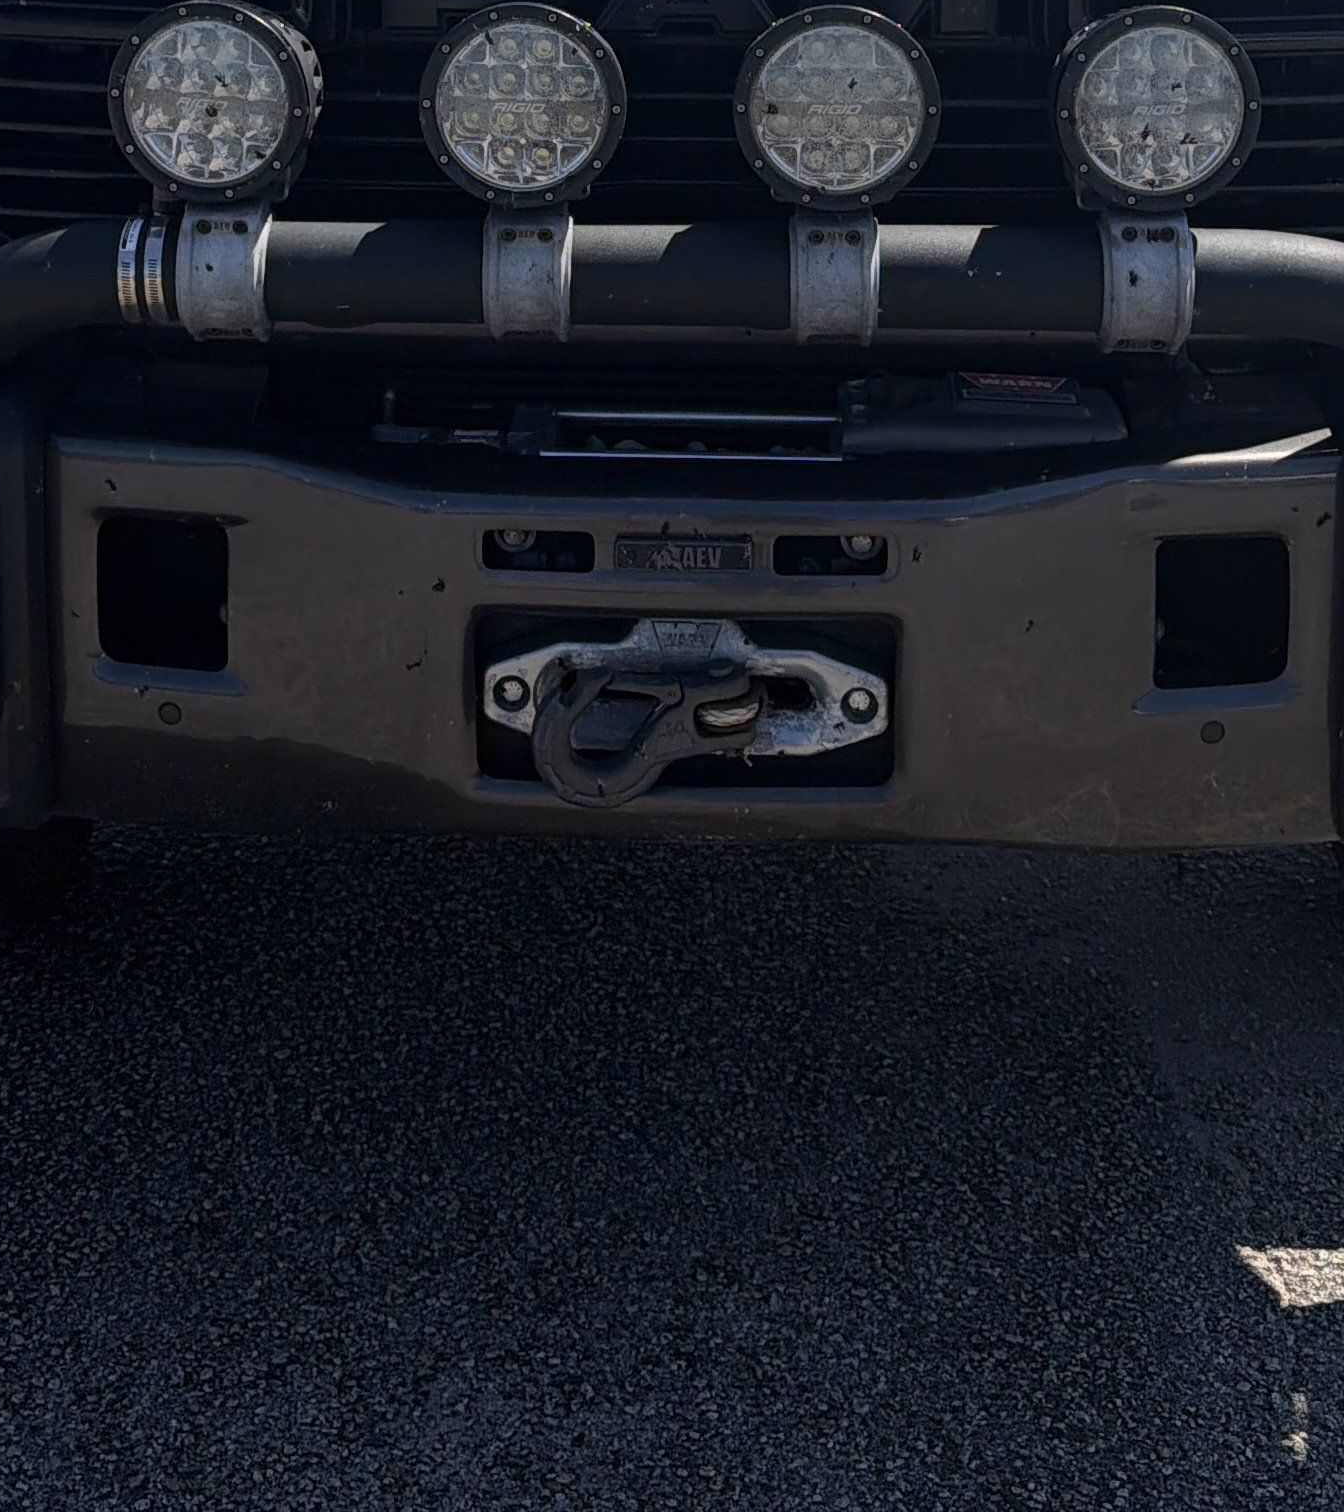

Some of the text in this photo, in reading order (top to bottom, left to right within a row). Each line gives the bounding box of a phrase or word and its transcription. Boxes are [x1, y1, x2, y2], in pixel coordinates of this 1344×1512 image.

[491, 101, 545, 115] RIGID
[807, 103, 863, 117] RIGID
[1132, 104, 1186, 118] RIGID
[682, 546, 722, 569] AEV
